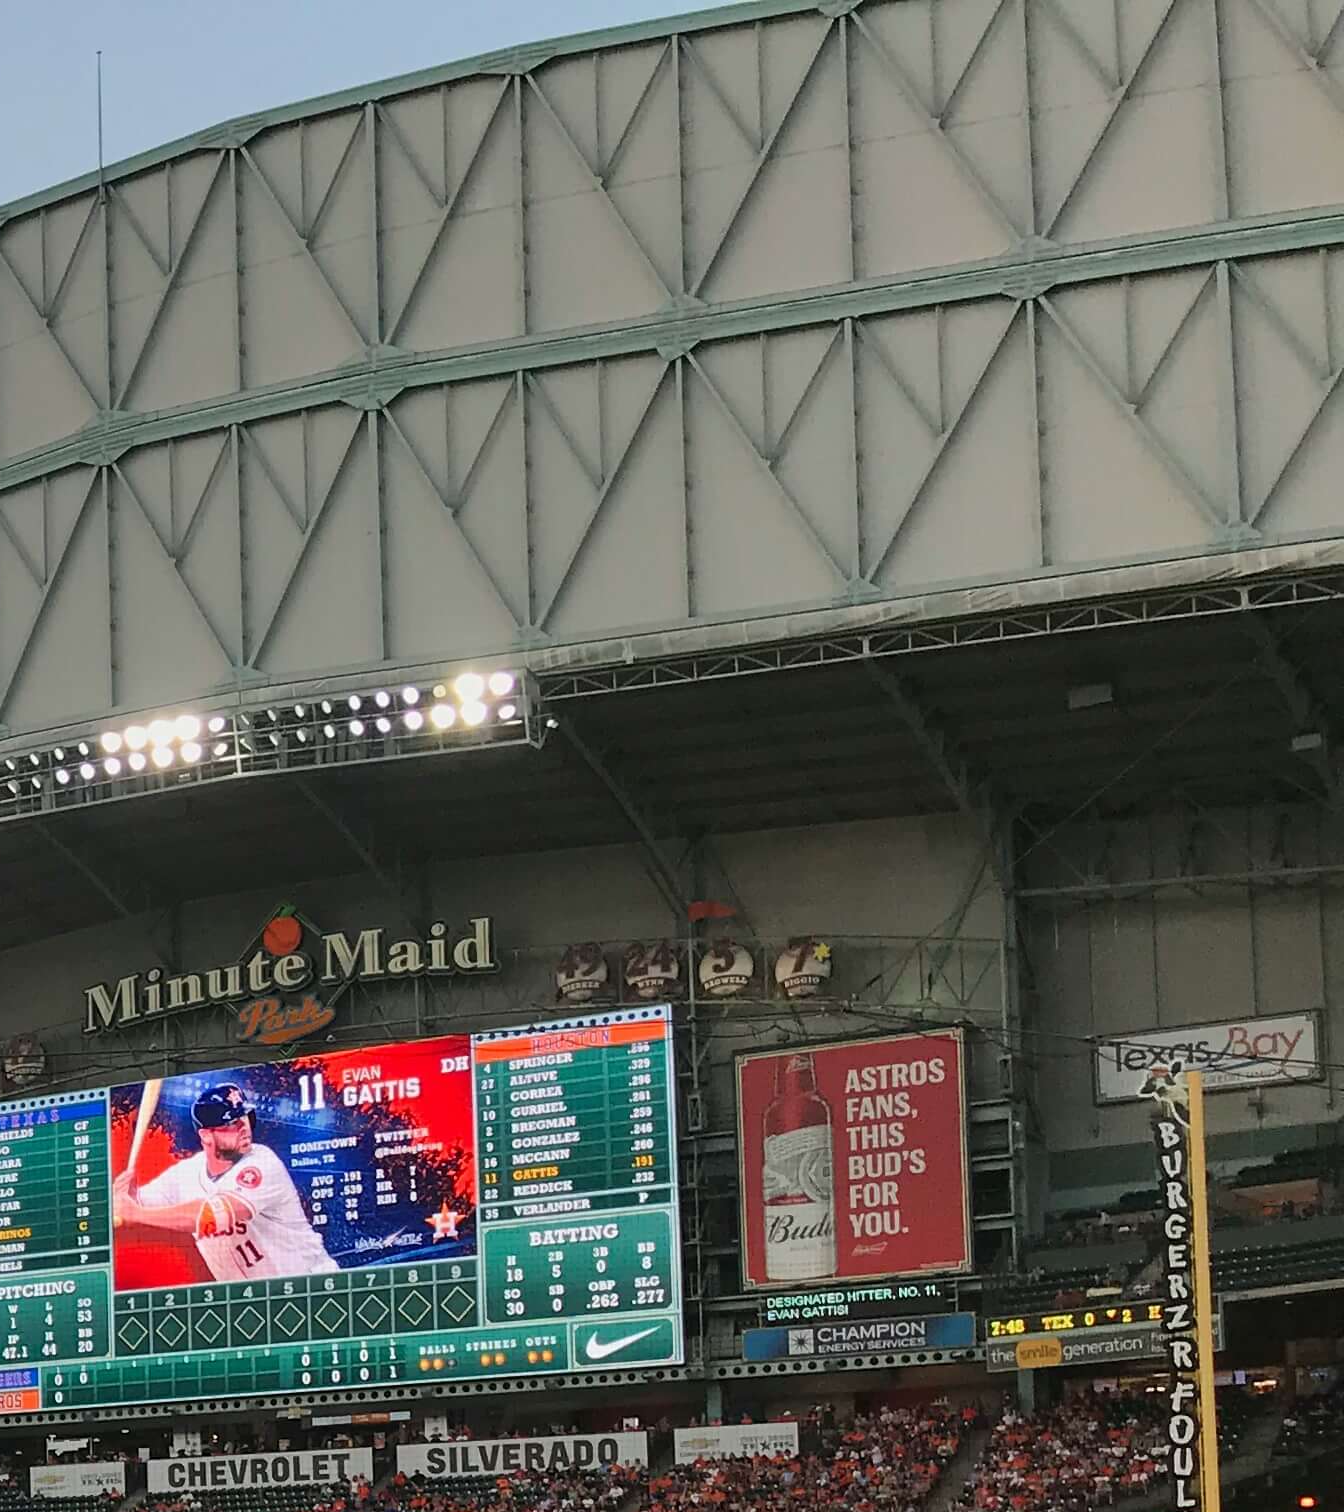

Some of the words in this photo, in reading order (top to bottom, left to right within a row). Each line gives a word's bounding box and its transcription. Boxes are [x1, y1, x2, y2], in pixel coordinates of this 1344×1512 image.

[83, 951, 311, 1032] Minute
[321, 917, 495, 980] Maid
[239, 998, 336, 1045] Park
[1226, 1026, 1304, 1066] Bay
[440, 1056, 469, 1074] DH
[508, 1053, 573, 1071] SPRINGER
[342, 1065, 381, 1085] EVAN
[510, 1071, 558, 1086] ALTUVE
[845, 1058, 945, 1093] ASTROS
[298, 1073, 326, 1112] 11
[343, 1077, 420, 1107] GATTIS
[510, 1086, 563, 1102] CORREA
[511, 1102, 567, 1118] GURRIEL
[846, 1092, 919, 1122] FANS,
[511, 1117, 577, 1134] BREGMAN
[846, 1122, 905, 1151] THIS
[290, 1137, 358, 1155] HOMETOWN
[374, 1128, 429, 1144] TWITTER
[512, 1131, 581, 1150] GONZALEZ
[512, 1149, 571, 1166] MCCANN
[848, 1149, 926, 1180] BUD'S
[513, 1166, 560, 1181] GATTIS
[513, 1181, 573, 1197] REDDICK
[849, 1181, 899, 1209] FOR
[514, 1200, 591, 1217] VERLANDER
[849, 1209, 909, 1238] YOU.
[528, 1224, 619, 1248] BATTING
[586, 1293, 620, 1309] .262
[631, 1289, 665, 1305] .277
[766, 1292, 845, 1309] DESIGNATED
[847, 1288, 896, 1302] HITTER,
[899, 1286, 921, 1299] NO.
[923, 1285, 941, 1297] 11.
[767, 1309, 800, 1321] EVAN
[1041, 1313, 1075, 1331] TEX
[525, 1335, 557, 1348] OUTS
[816, 1321, 926, 1343] CHAMPION
[817, 1341, 864, 1353] ENERGY
[866, 1336, 926, 1351] SERVICES
[990, 1348, 1016, 1364] the
[1019, 1342, 1060, 1360] smile
[1062, 1336, 1143, 1360] generation
[426, 1437, 619, 1475] SILVERADO
[1168, 1381, 1196, 1508] FOUL
[167, 1453, 351, 1488] CHEVROLET
